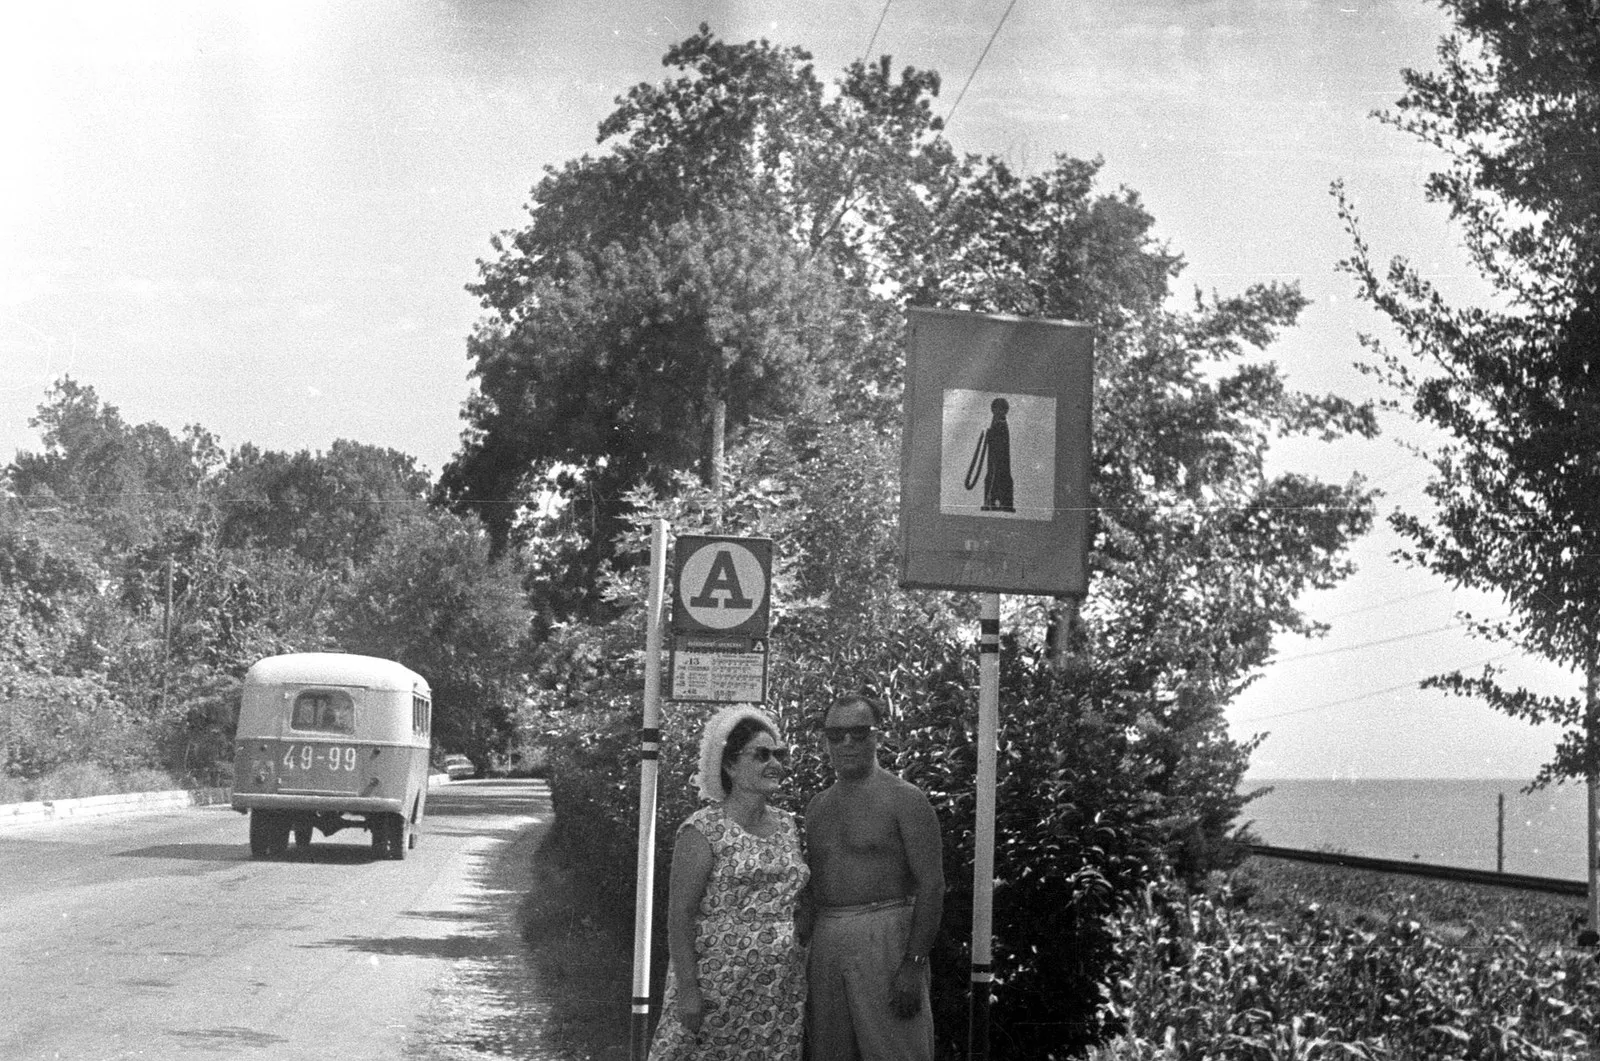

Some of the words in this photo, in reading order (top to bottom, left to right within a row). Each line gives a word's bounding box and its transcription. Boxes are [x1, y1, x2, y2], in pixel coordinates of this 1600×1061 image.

[690, 551, 753, 609] А
[752, 640, 765, 652] А
[283, 745, 356, 771] 49-99
